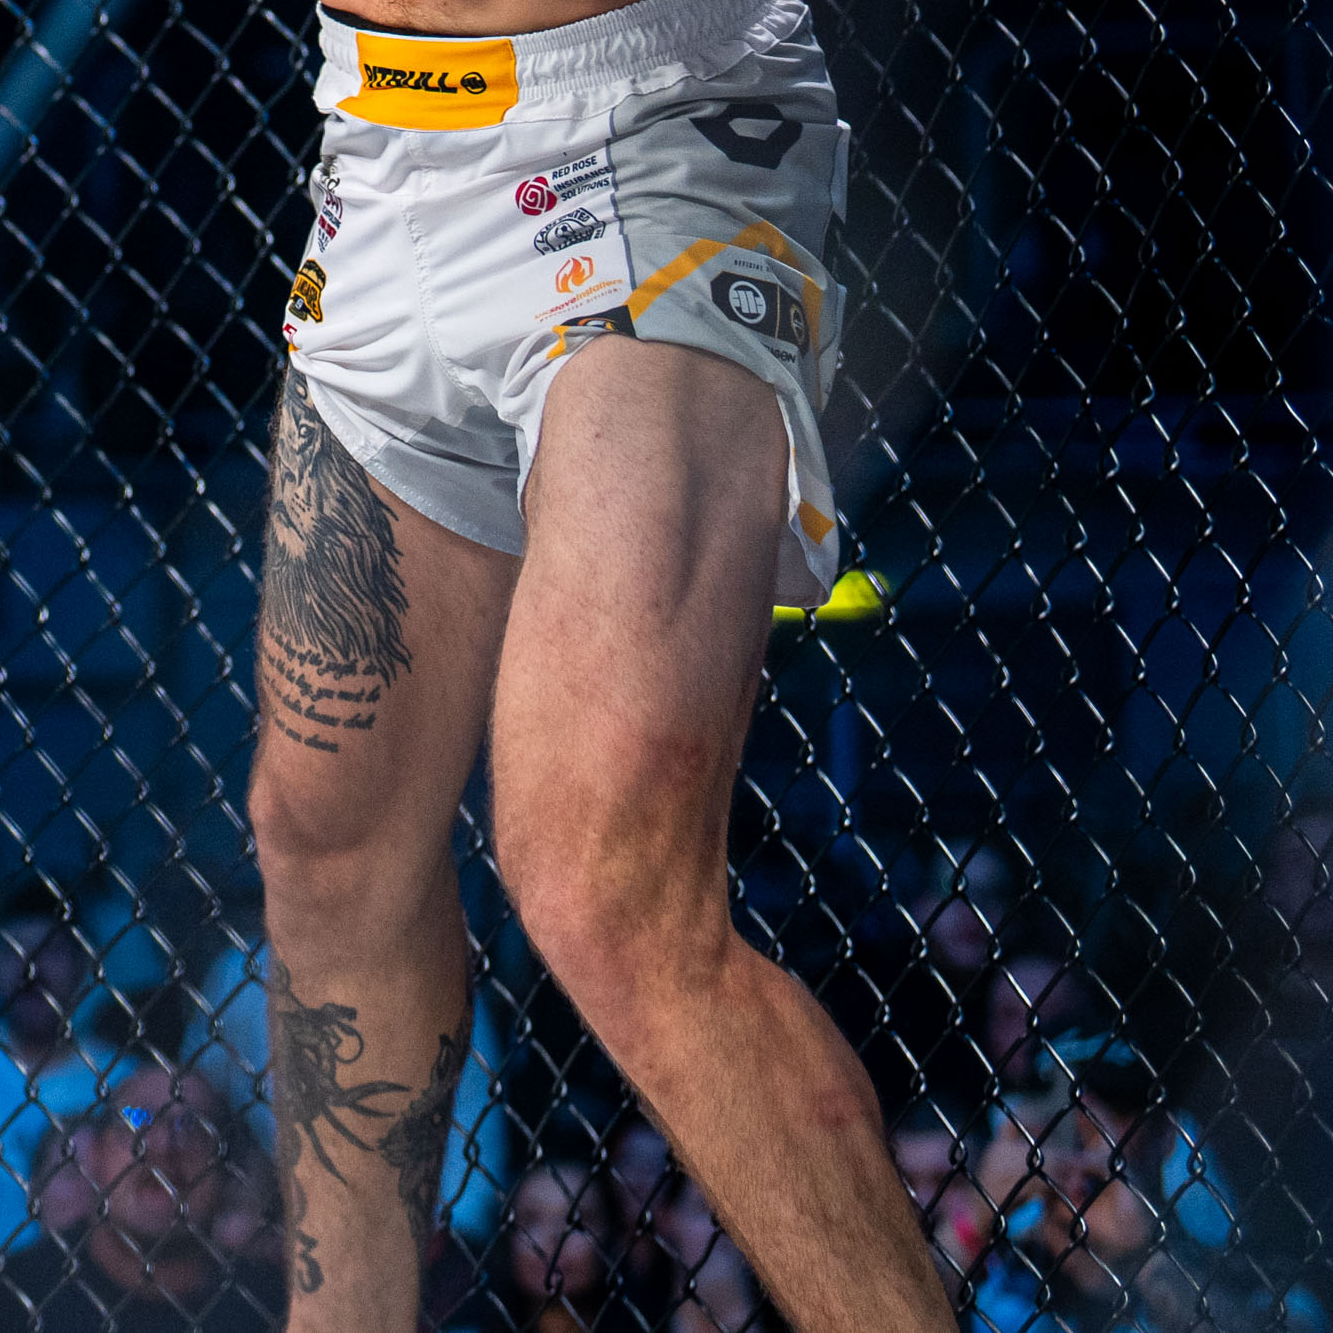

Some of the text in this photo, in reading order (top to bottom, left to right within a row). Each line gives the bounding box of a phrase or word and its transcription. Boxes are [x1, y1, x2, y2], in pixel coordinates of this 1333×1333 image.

[551, 155, 598, 181] RED ROSE
[553, 165, 613, 193] INSURANCE
[560, 177, 611, 203] SOLUTIONS
